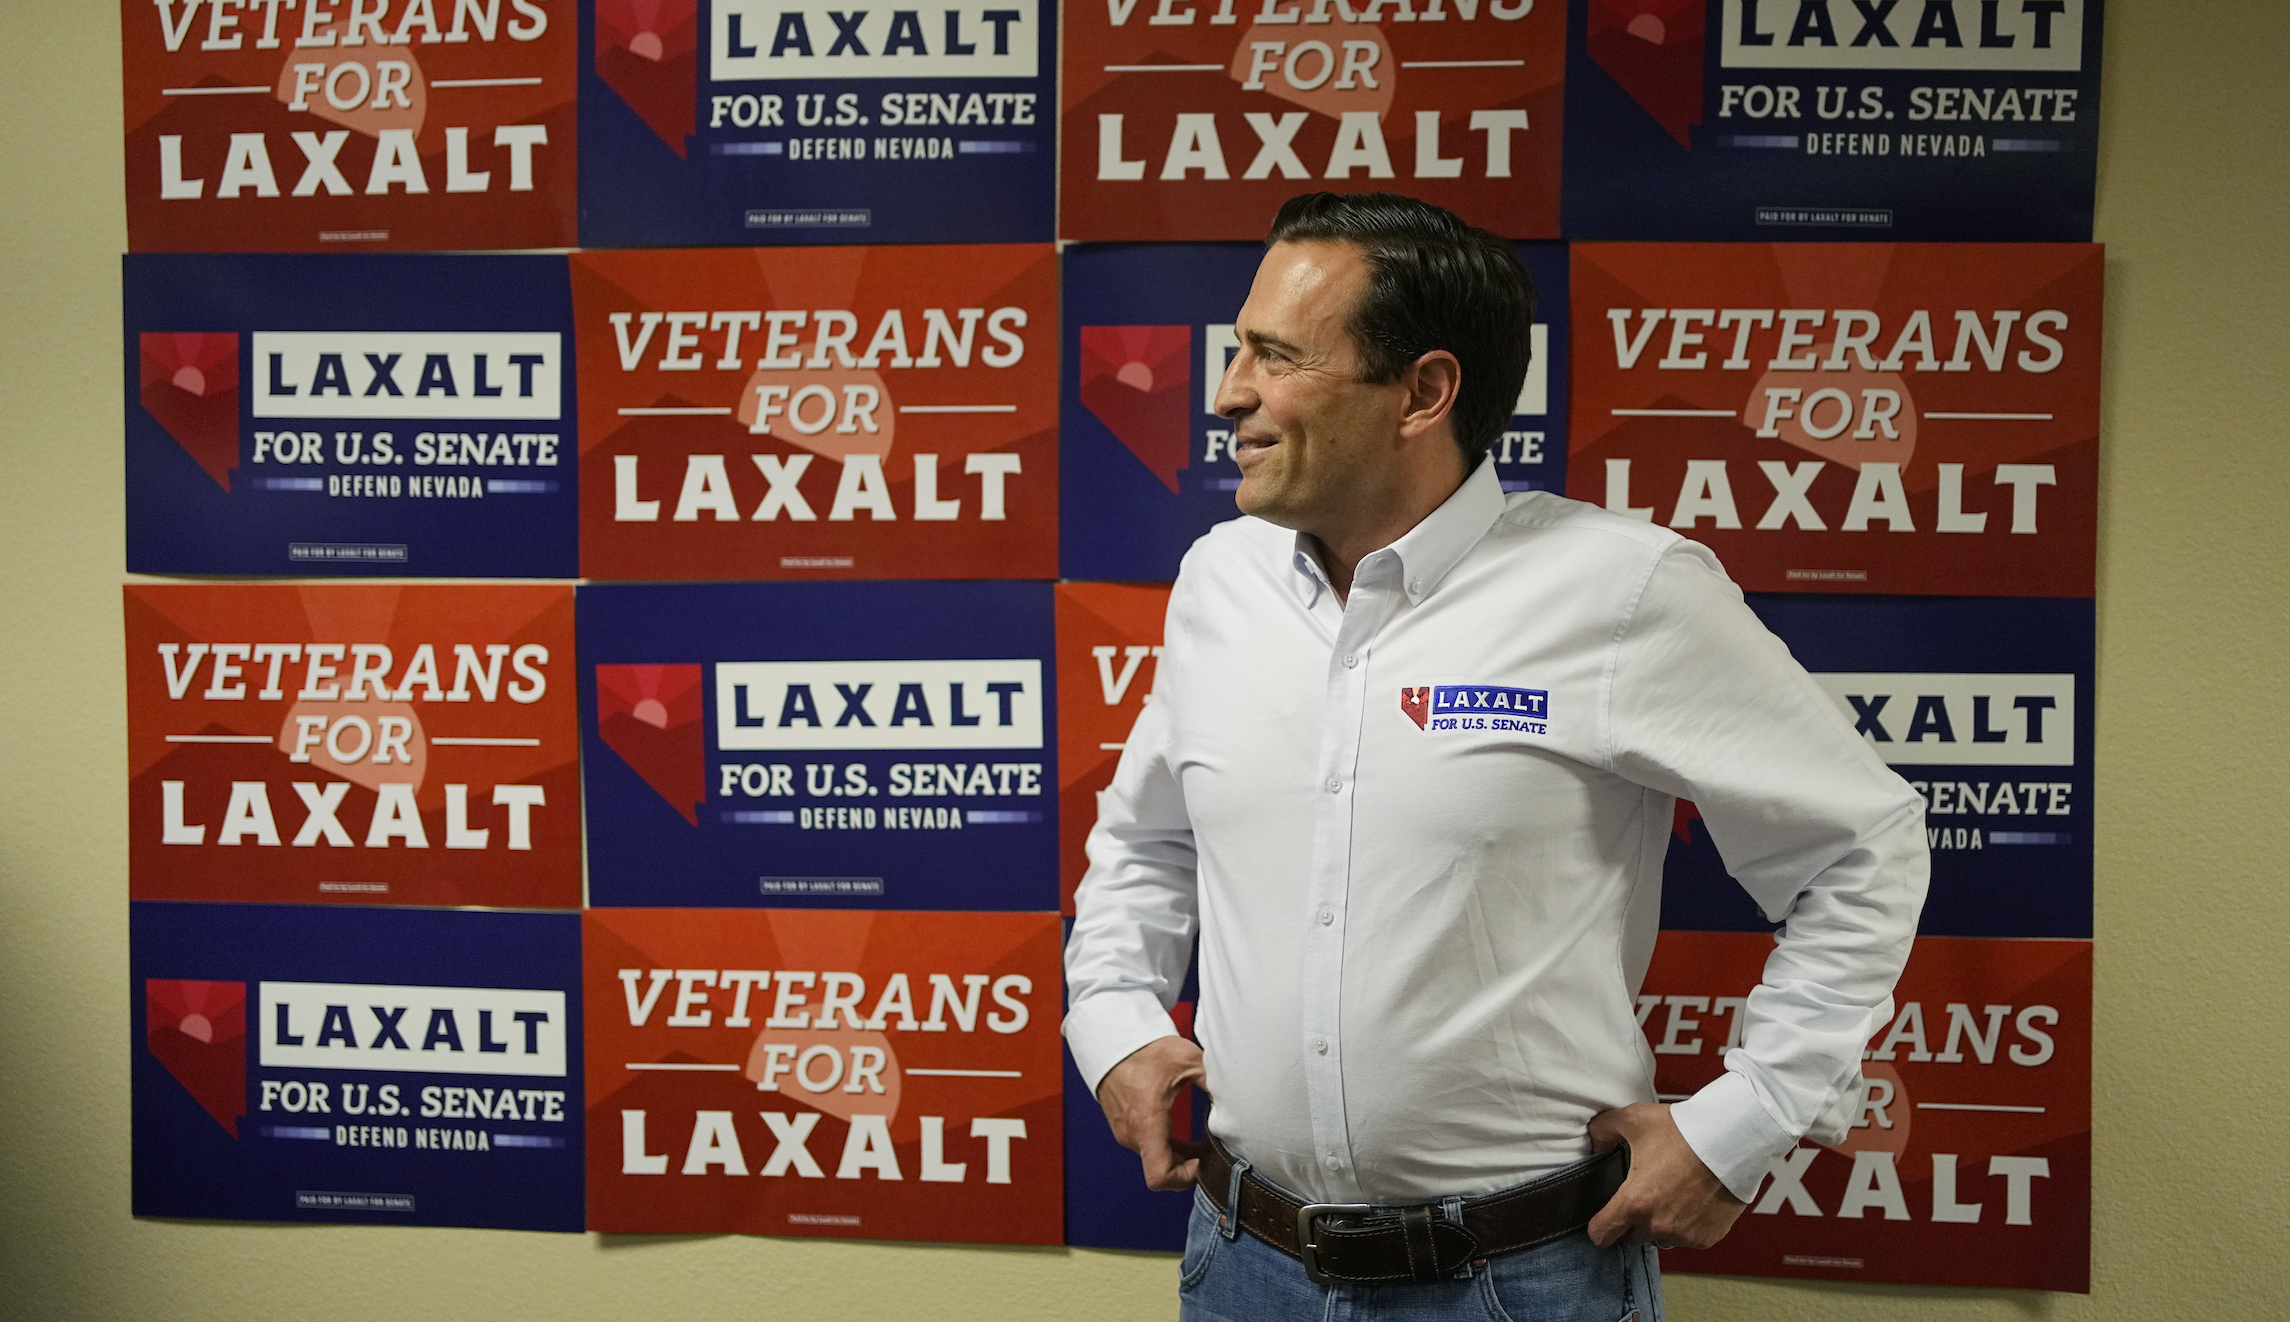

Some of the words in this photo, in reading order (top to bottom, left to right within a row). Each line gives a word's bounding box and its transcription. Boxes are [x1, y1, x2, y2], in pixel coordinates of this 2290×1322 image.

[153, 0, 547, 52] VETERANS
[727, 9, 1021, 59] LAXALT
[1739, 0, 2066, 49] LAXALT
[288, 60, 411, 111] FOR
[1242, 39, 1380, 91] FOR
[709, 94, 784, 128] FOR
[796, 93, 869, 127] U.S.
[880, 92, 1037, 126] SENATE
[1718, 84, 1801, 118] FOR
[1816, 86, 1895, 120] U.S.
[1908, 86, 2078, 122] SENATE
[158, 124, 548, 200] LAXALT
[789, 137, 866, 160] DEFEND
[874, 137, 954, 160] NEVADA
[1097, 109, 1529, 181] LAXALT
[1806, 132, 1890, 156] DEFEND
[1900, 134, 1985, 157] NEVADA
[609, 307, 1028, 371] VETERANS
[1606, 308, 2069, 373] VETERANS
[268, 352, 545, 398] LAXALT
[749, 384, 880, 434] FOR
[1755, 387, 1901, 439] FOR
[252, 431, 324, 464] FOR
[335, 432, 403, 465] U.S.
[414, 432, 559, 466] SENATE
[329, 474, 401, 498] DEFEND
[408, 475, 483, 498] NEVADA
[613, 452, 1022, 522] LAXALT
[1605, 458, 2057, 534] LAXALT
[157, 643, 549, 704] VETERANS
[733, 682, 1024, 728] LAXALT
[1437, 690, 1544, 712] LAXALT
[1845, 694, 2057, 744] XALT
[289, 714, 413, 764] FOR
[1431, 718, 1458, 731] FOR
[1462, 718, 1488, 731] U.S.
[1491, 718, 1547, 735] SENATE
[719, 763, 795, 797] FOR
[805, 763, 878, 797] U.S.
[889, 763, 1042, 797] SENATE
[161, 780, 546, 851] LAXALT
[800, 807, 876, 830] DEFEND
[884, 807, 962, 830] NEVADA
[1927, 826, 1983, 850] VADA
[618, 969, 1032, 1034] VETERANS
[275, 1003, 549, 1055] LAXALT
[1634, 995, 2060, 1067] ETANS
[757, 1043, 886, 1094] FOR
[259, 1080, 331, 1113] FOR
[341, 1083, 410, 1116] U.S.
[420, 1086, 565, 1122] SENATE
[336, 1125, 408, 1148] DEFEND
[415, 1128, 490, 1151] NEVADA
[621, 1109, 1027, 1184] LAXALT
[1752, 1146, 2051, 1226] XALT
